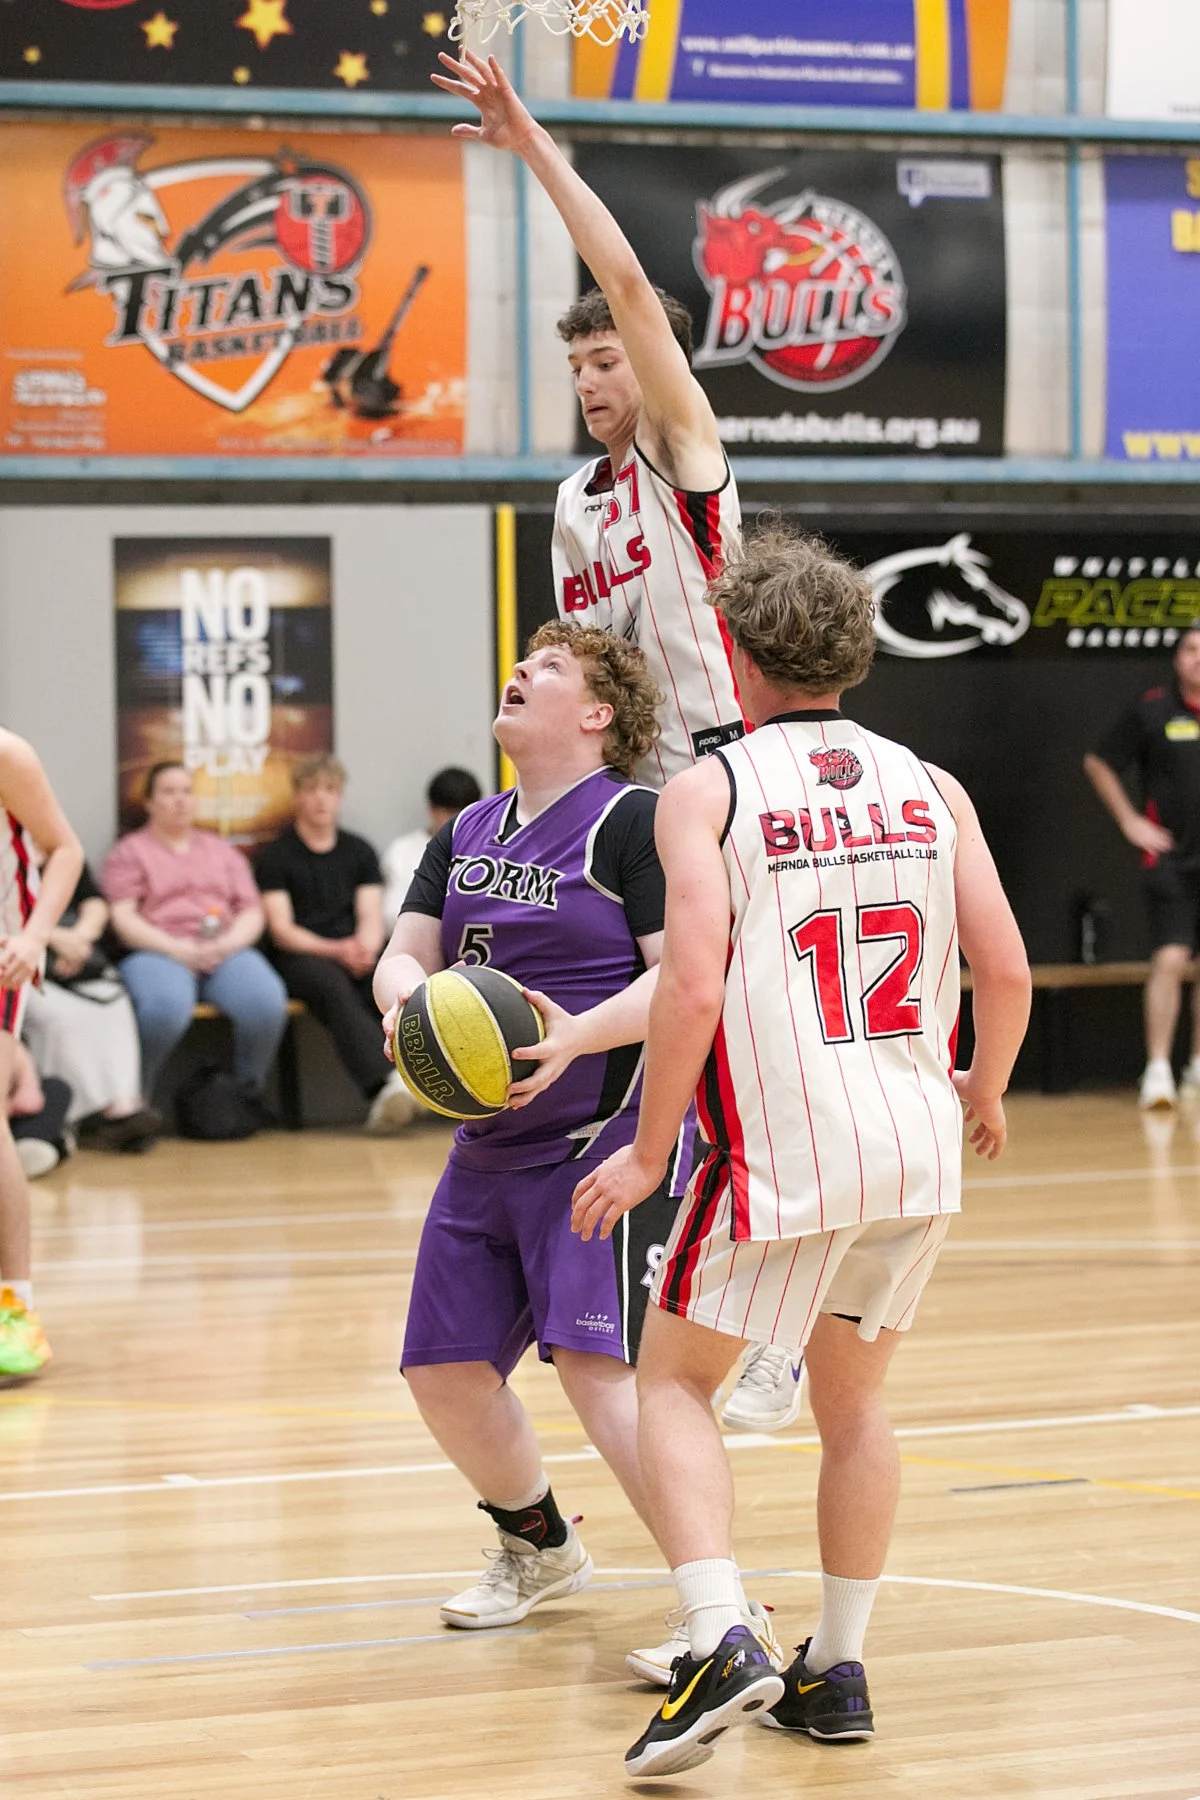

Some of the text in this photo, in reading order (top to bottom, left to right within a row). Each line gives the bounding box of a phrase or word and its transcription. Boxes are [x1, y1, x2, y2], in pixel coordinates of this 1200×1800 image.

[104, 266, 358, 343] TITANS
[703, 278, 903, 352] BULLS
[716, 411, 980, 449] erndabulls.org.au
[180, 566, 270, 641] NO
[182, 641, 271, 675] REFS
[182, 673, 271, 746] NO
[729, 729, 739, 741] M
[183, 745, 270, 776] PLAY
[816, 764, 865, 787] BULLS
[758, 799, 937, 857] BULLS
[767, 848, 938, 875] MERNDA BULLS BASKETBALL CLUB
[457, 923, 494, 966] 5
[787, 899, 924, 1045] 12
